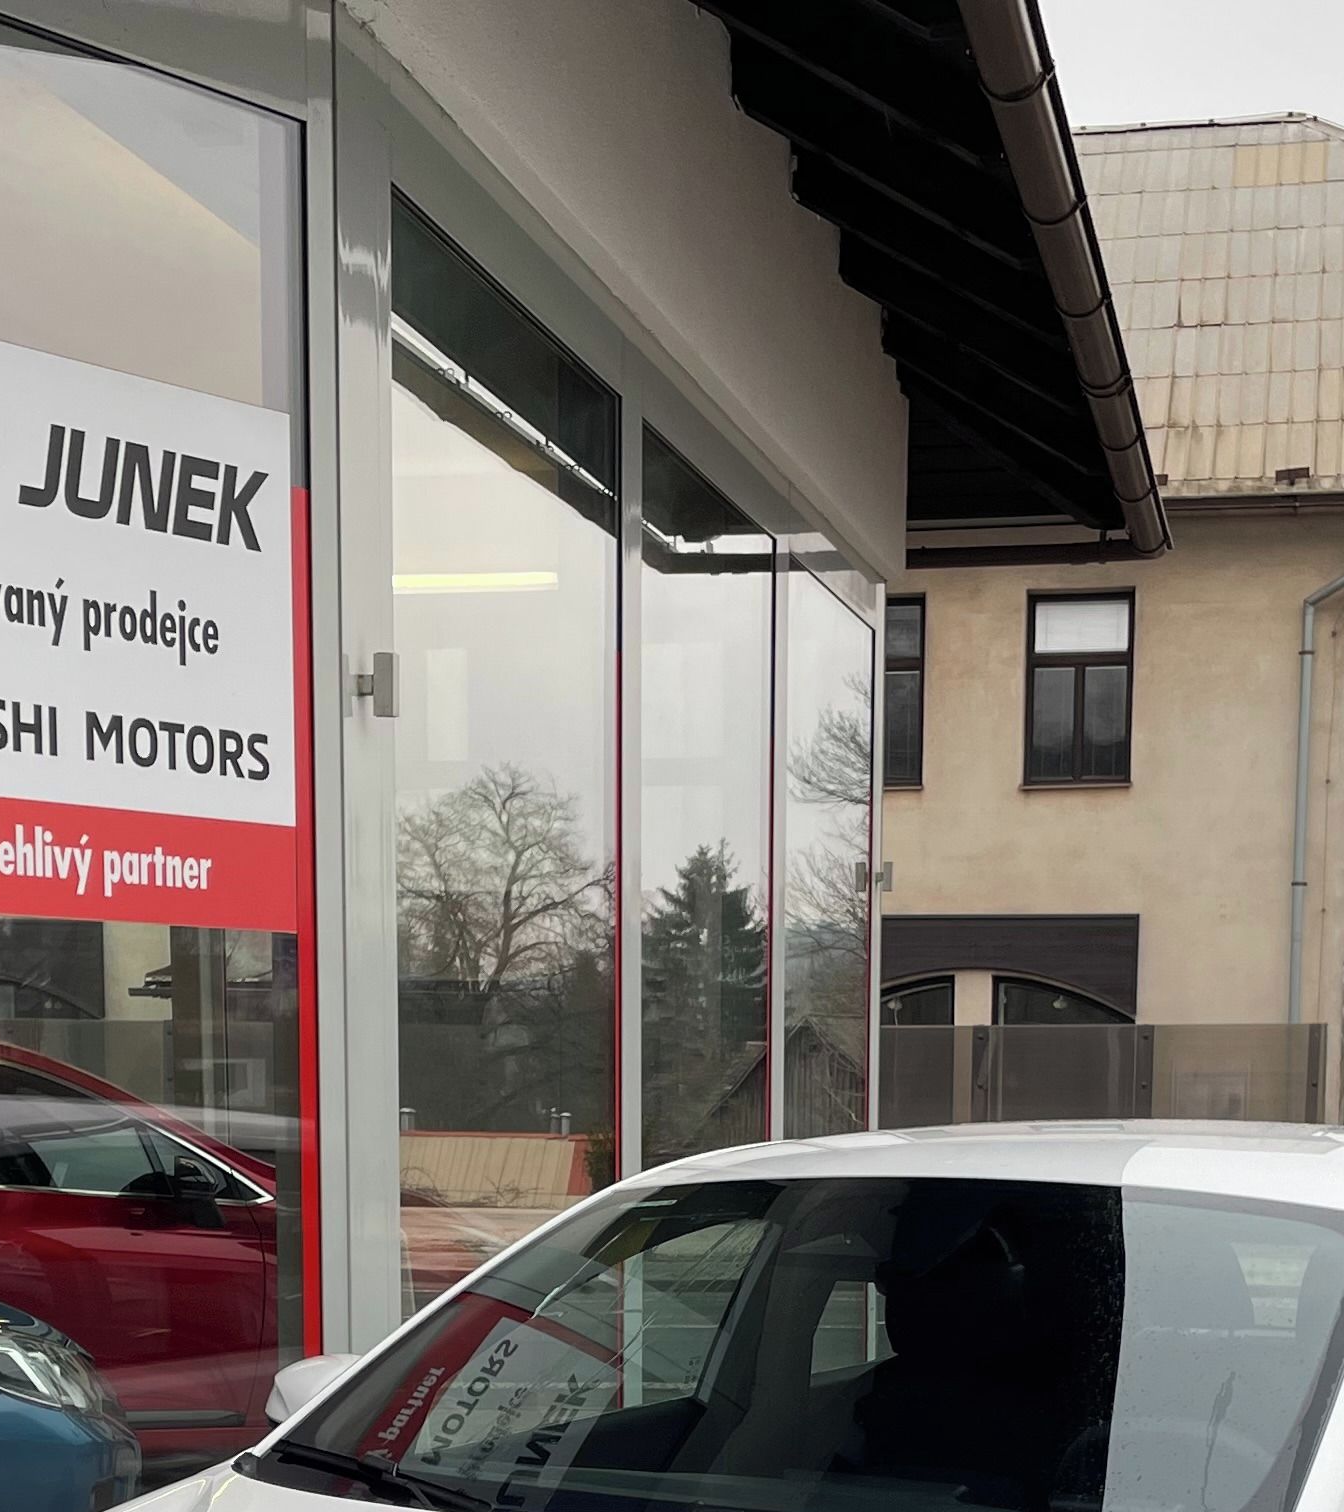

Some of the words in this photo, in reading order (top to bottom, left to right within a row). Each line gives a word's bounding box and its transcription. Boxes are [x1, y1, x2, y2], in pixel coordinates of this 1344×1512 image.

[17, 423, 270, 554] JUNEK
[81, 589, 220, 666] prodejce
[84, 711, 271, 782] MOTORS
[102, 844, 214, 898] partner
